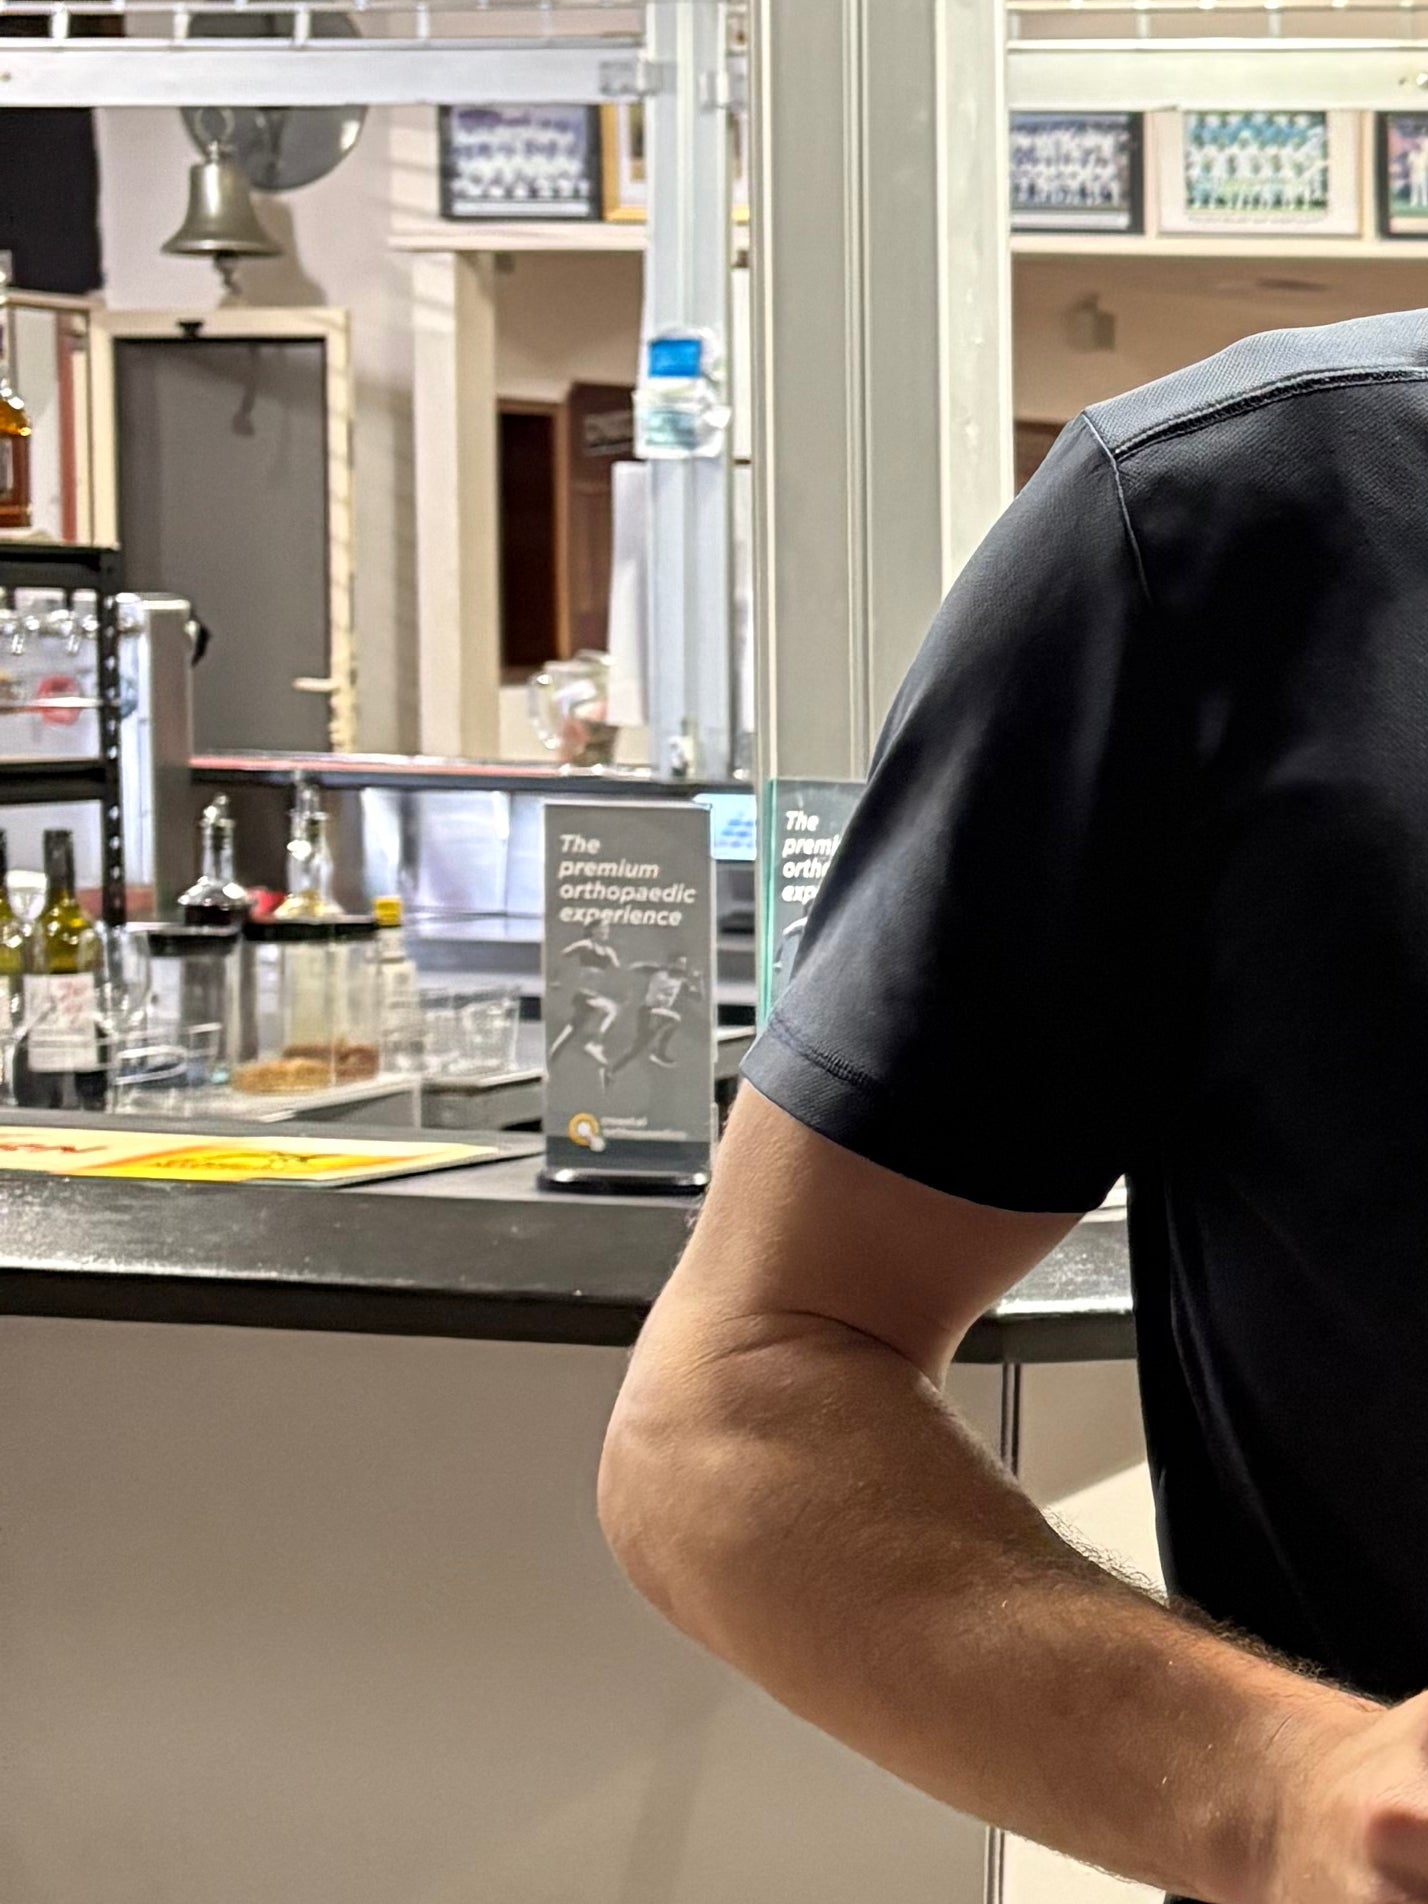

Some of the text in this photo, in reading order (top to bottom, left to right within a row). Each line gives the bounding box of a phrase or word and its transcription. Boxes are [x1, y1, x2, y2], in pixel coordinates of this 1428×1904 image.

[785, 810, 819, 831] The
[559, 833, 601, 855] The
[558, 857, 660, 879] premium
[559, 880, 697, 905] orthopaedic
[559, 904, 683, 927] experience
